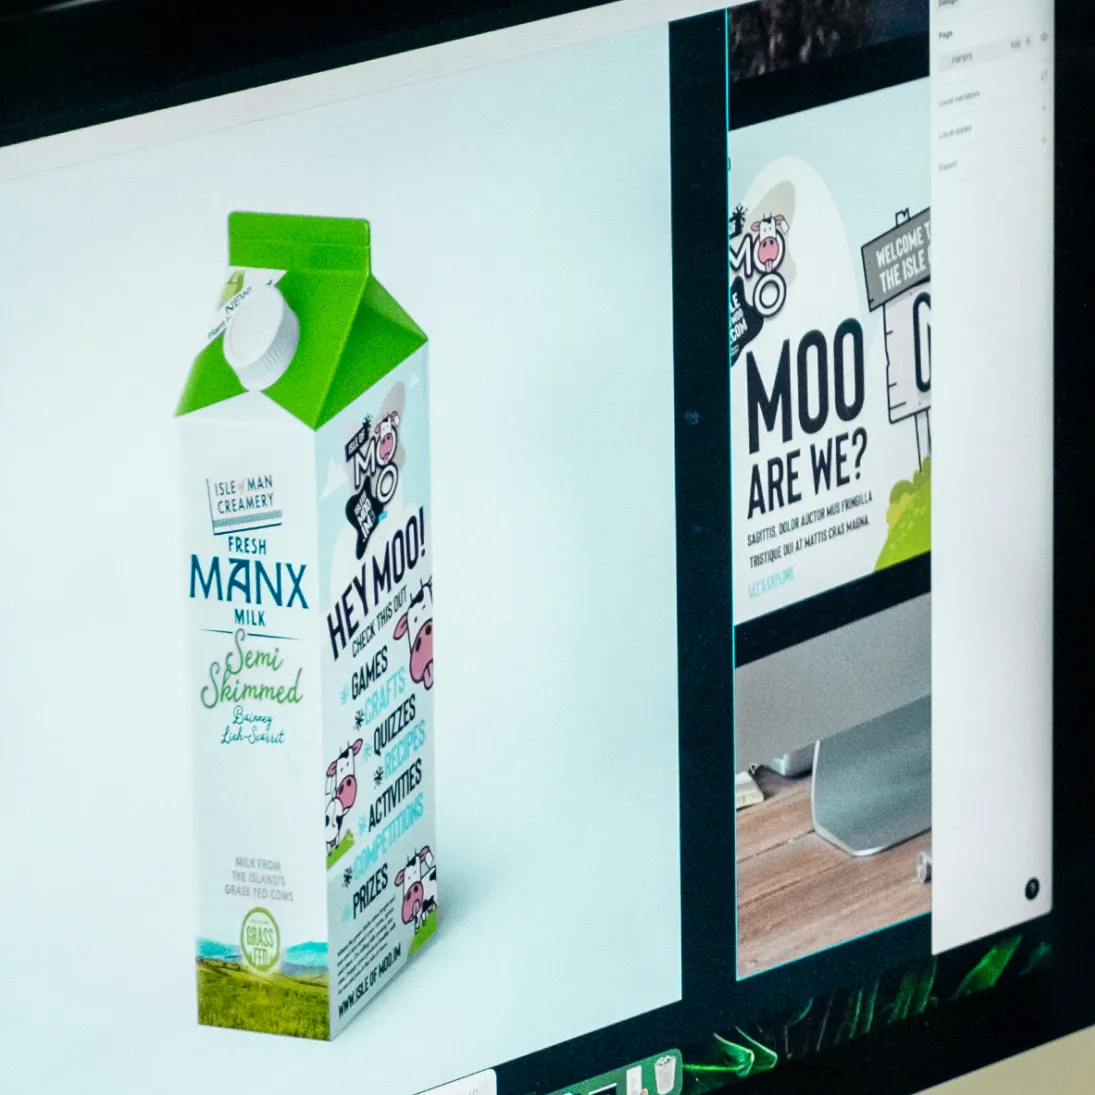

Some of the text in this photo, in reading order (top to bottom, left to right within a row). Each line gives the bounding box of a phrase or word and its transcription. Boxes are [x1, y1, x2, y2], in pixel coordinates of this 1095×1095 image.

[876, 225, 925, 269] WELCOME
[879, 248, 927, 293] THE ISLE
[746, 317, 866, 455] MOO
[214, 480, 236, 496] ISLE
[247, 474, 273, 492] MAN
[747, 426, 868, 520] ARE WE?
[217, 492, 274, 514] CREAMERY
[778, 517, 800, 536] DOLOR
[800, 508, 826, 526] AUCTOR
[826, 503, 840, 518] MUS
[841, 490, 873, 512] FRINGILLA
[228, 536, 268, 555] FRESH
[750, 545, 782, 569] TRISTIQUE
[783, 541, 794, 557] DUI
[795, 538, 804, 552] AT
[804, 529, 828, 549] MATTIS
[828, 522, 845, 540] CRAS
[189, 554, 310, 610] MANX
[326, 506, 426, 662] HEY MOO!
[234, 608, 266, 627] MILK
[352, 584, 408, 658] CHECK THIS OUT
[225, 628, 284, 675] Semi
[352, 644, 388, 700] GAMES
[200, 661, 304, 709] Skimmed
[364, 664, 406, 726] CRAFTS
[374, 693, 416, 756] QUIZZES
[384, 718, 426, 780] RECIPES
[368, 757, 422, 832] ACTIVITIES
[353, 792, 424, 881] COMPETITIONS
[232, 870, 286, 886] THE ISLAND'S
[235, 856, 281, 872] MILK FROM
[224, 884, 294, 902] GRASS FED COWS
[353, 862, 388, 920] PRIZES
[246, 926, 274, 948] GRASS
[369, 966, 377, 986] OF
